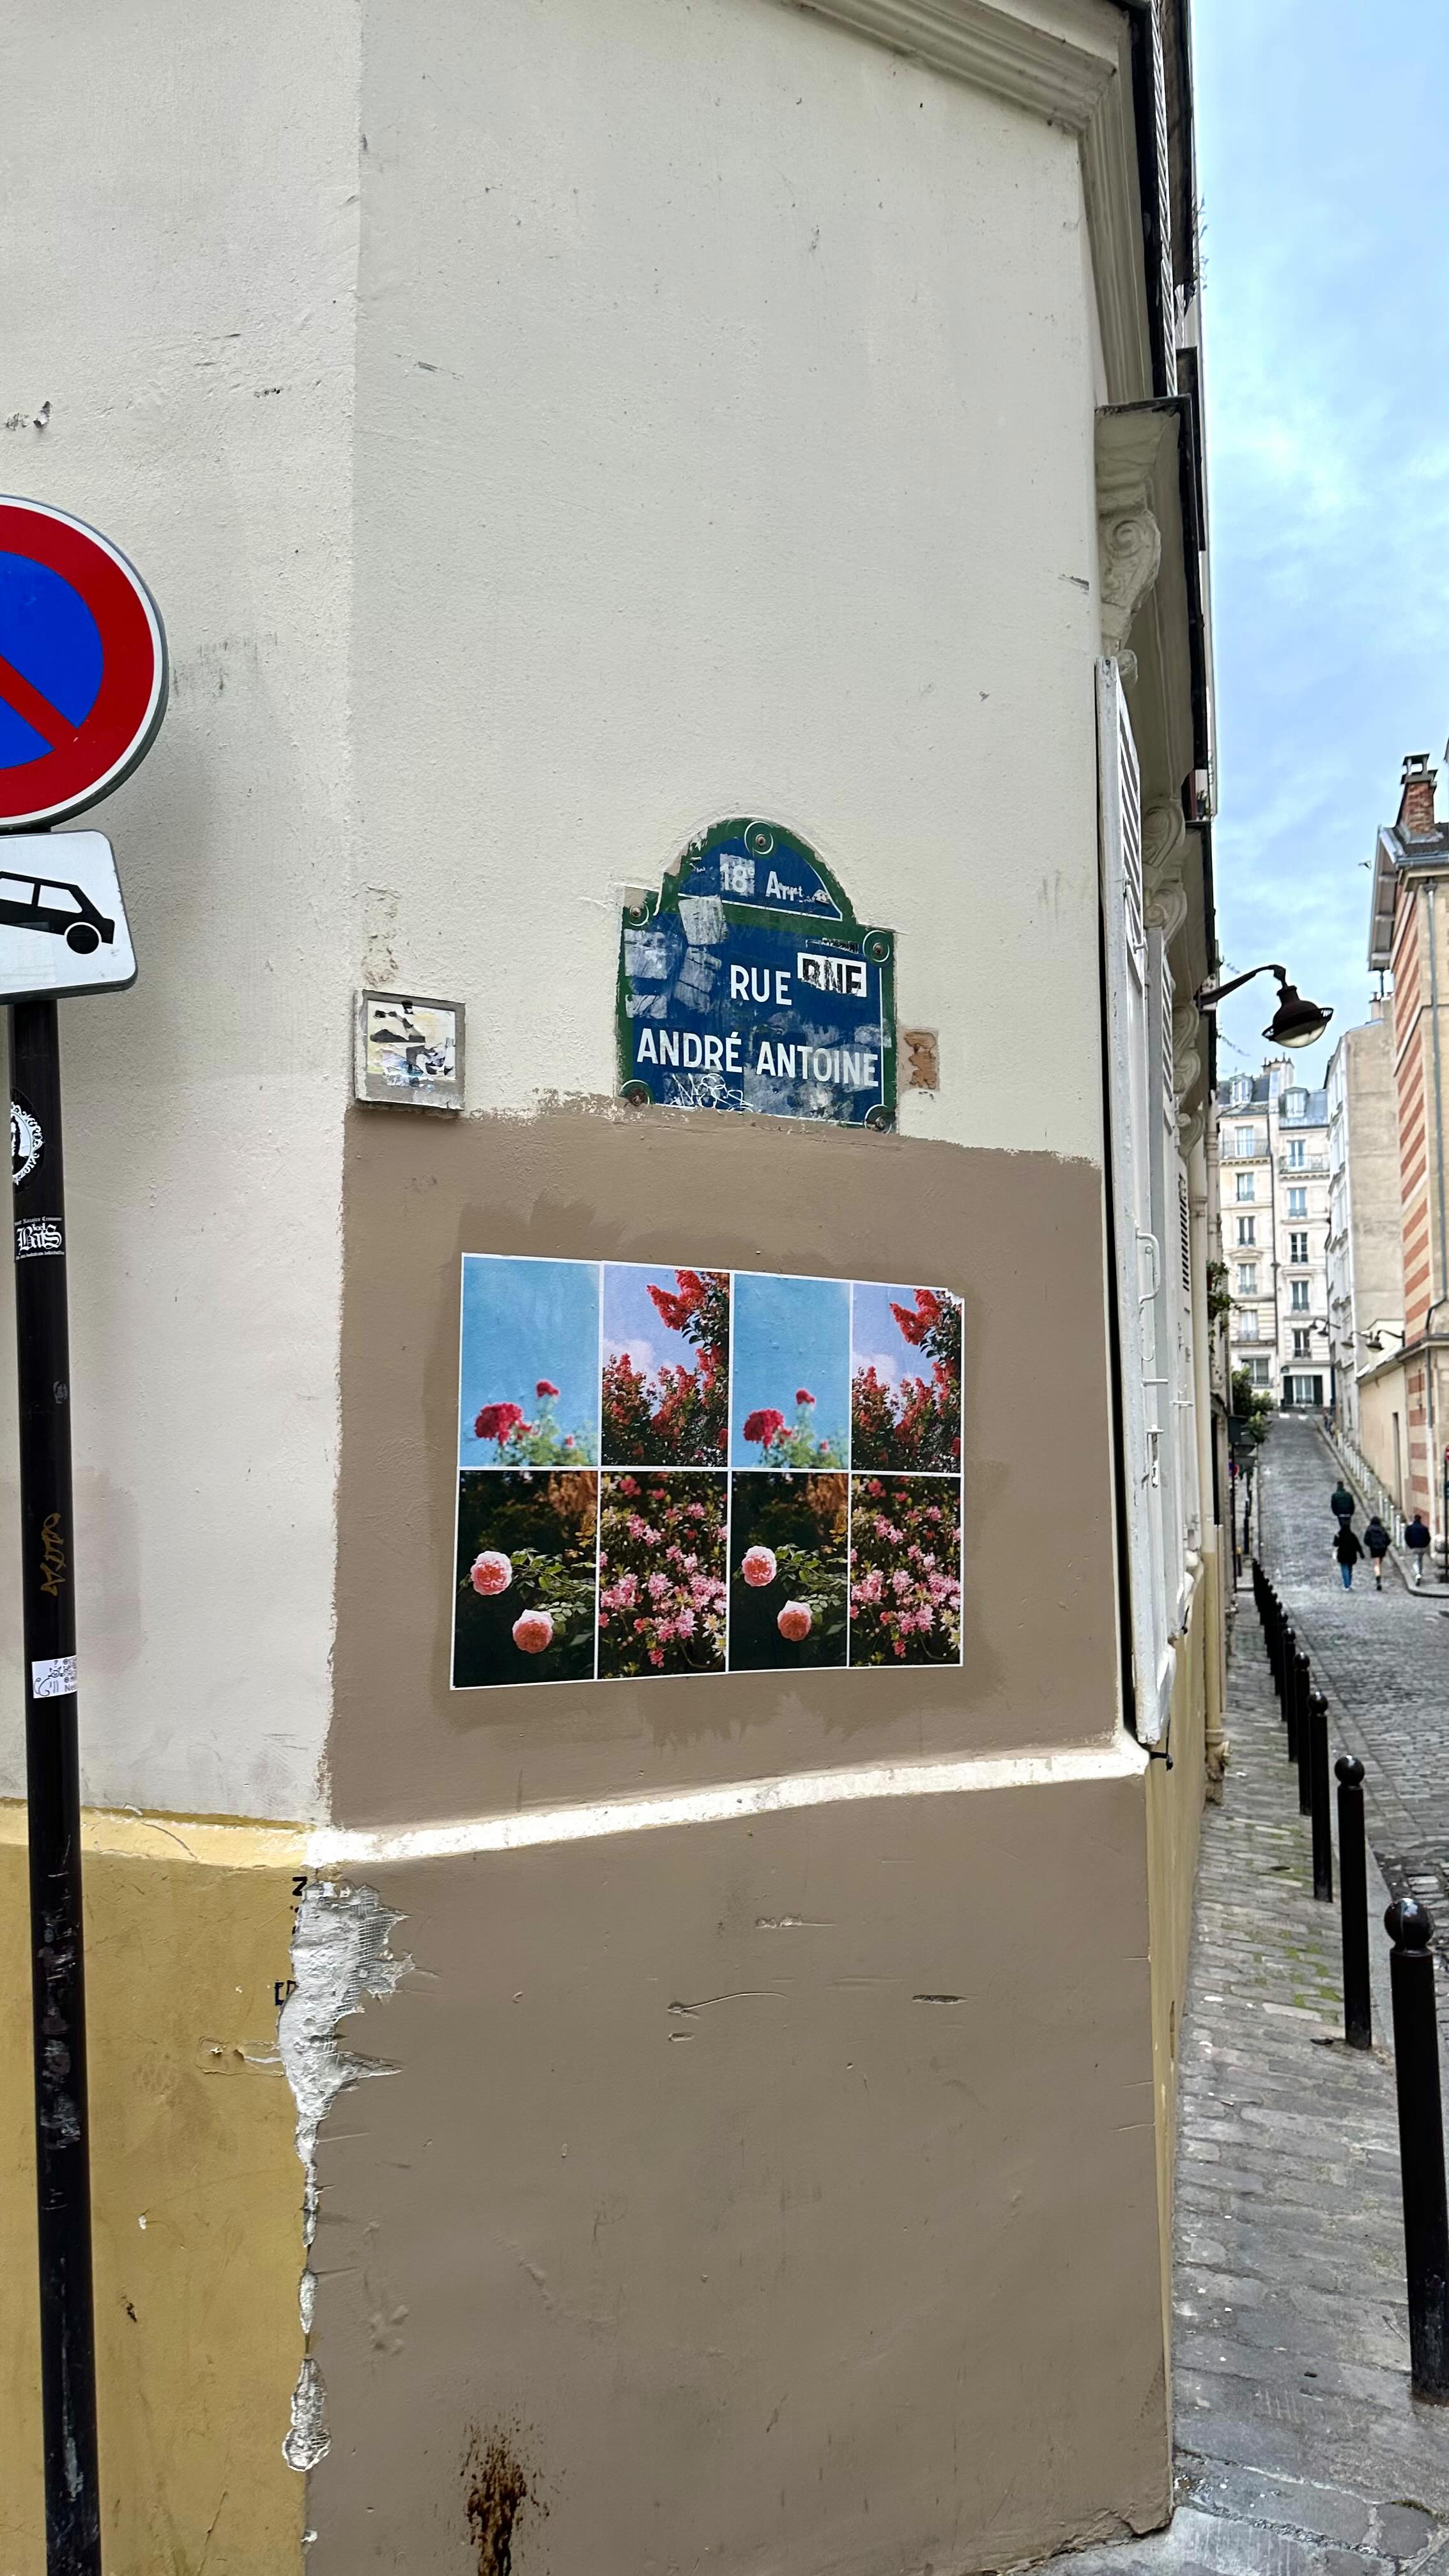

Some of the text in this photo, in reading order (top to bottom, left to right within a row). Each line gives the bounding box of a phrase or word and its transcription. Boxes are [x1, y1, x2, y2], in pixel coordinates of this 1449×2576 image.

[730, 964, 792, 1006] RUE
[636, 1027, 880, 1087] ANDRÉ ANTOINE
